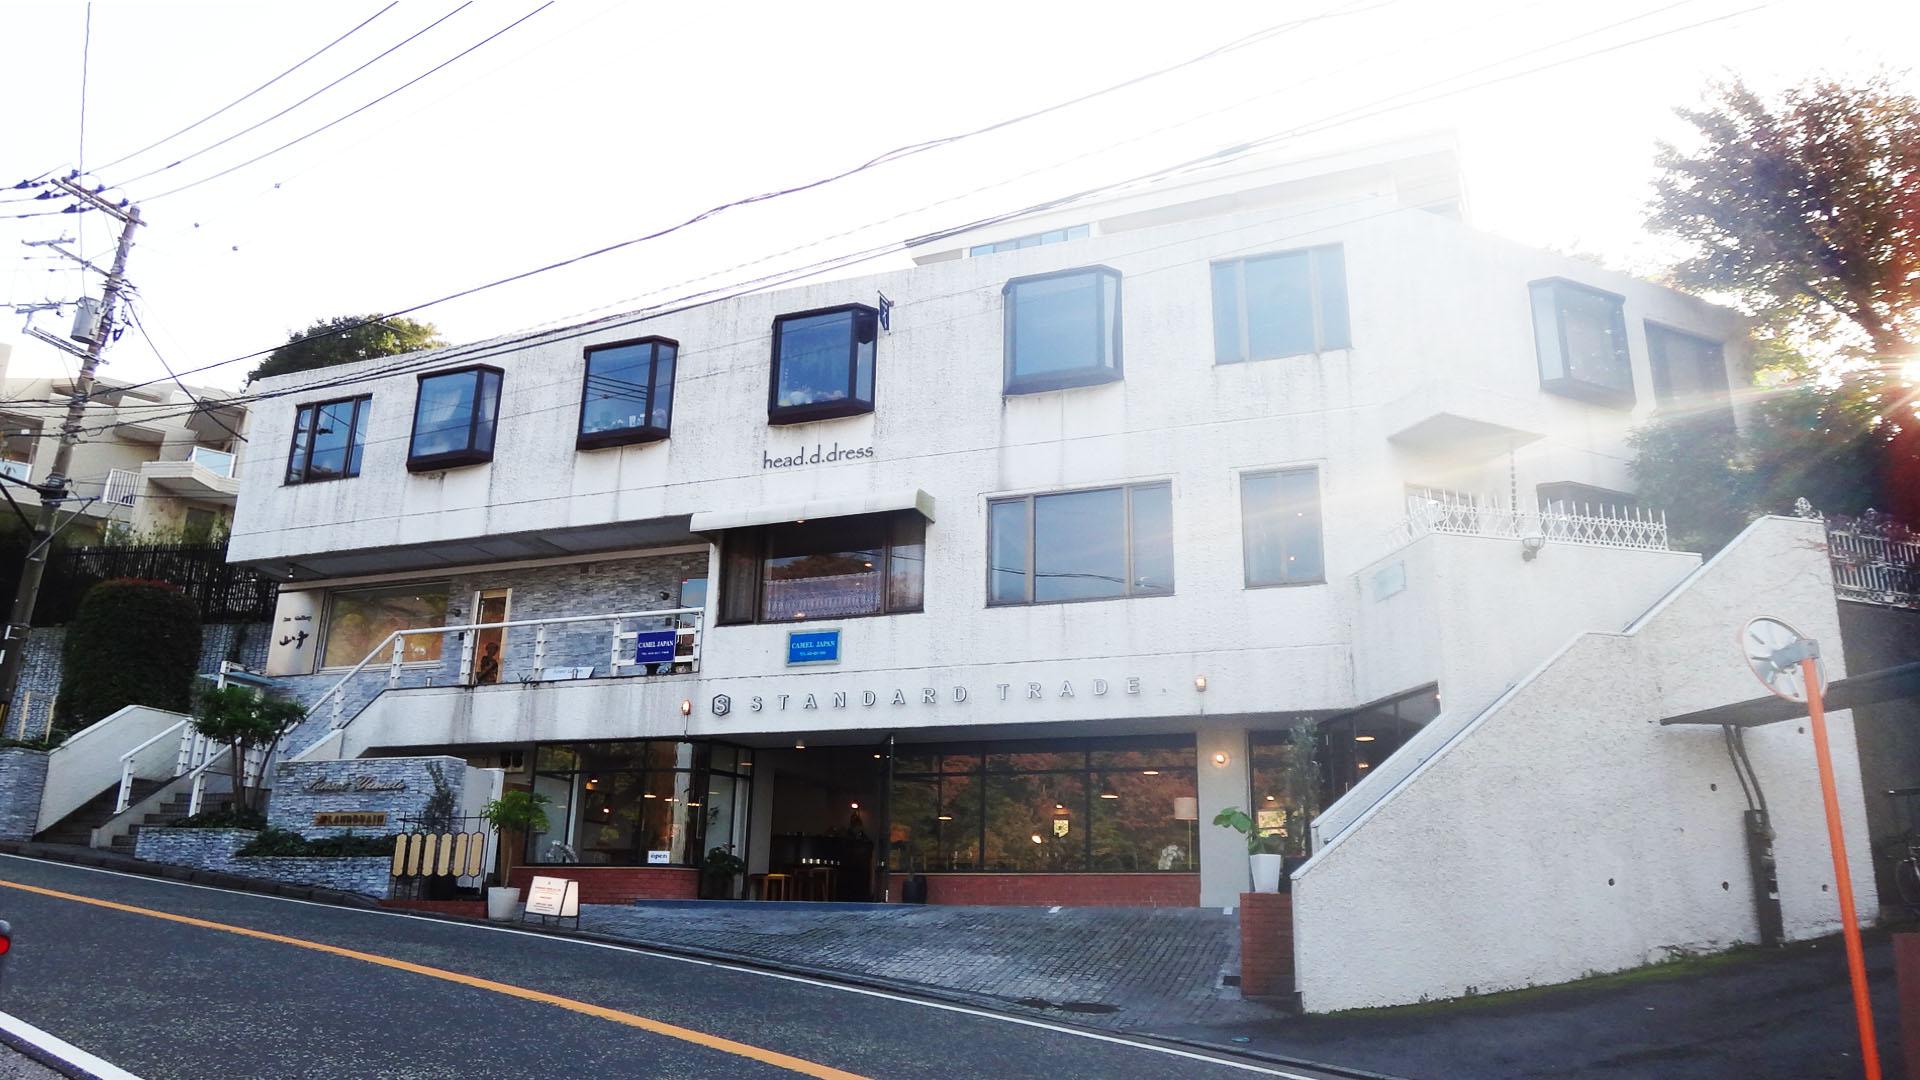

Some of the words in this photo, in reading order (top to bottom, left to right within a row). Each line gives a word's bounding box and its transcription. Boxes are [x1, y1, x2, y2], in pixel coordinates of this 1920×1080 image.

[763, 442, 874, 469] head.d.dress
[638, 641, 656, 649] CAMEL
[791, 641, 815, 649] CAMEL
[816, 640, 836, 648] JAPAN
[752, 686, 967, 712] STANDARD
